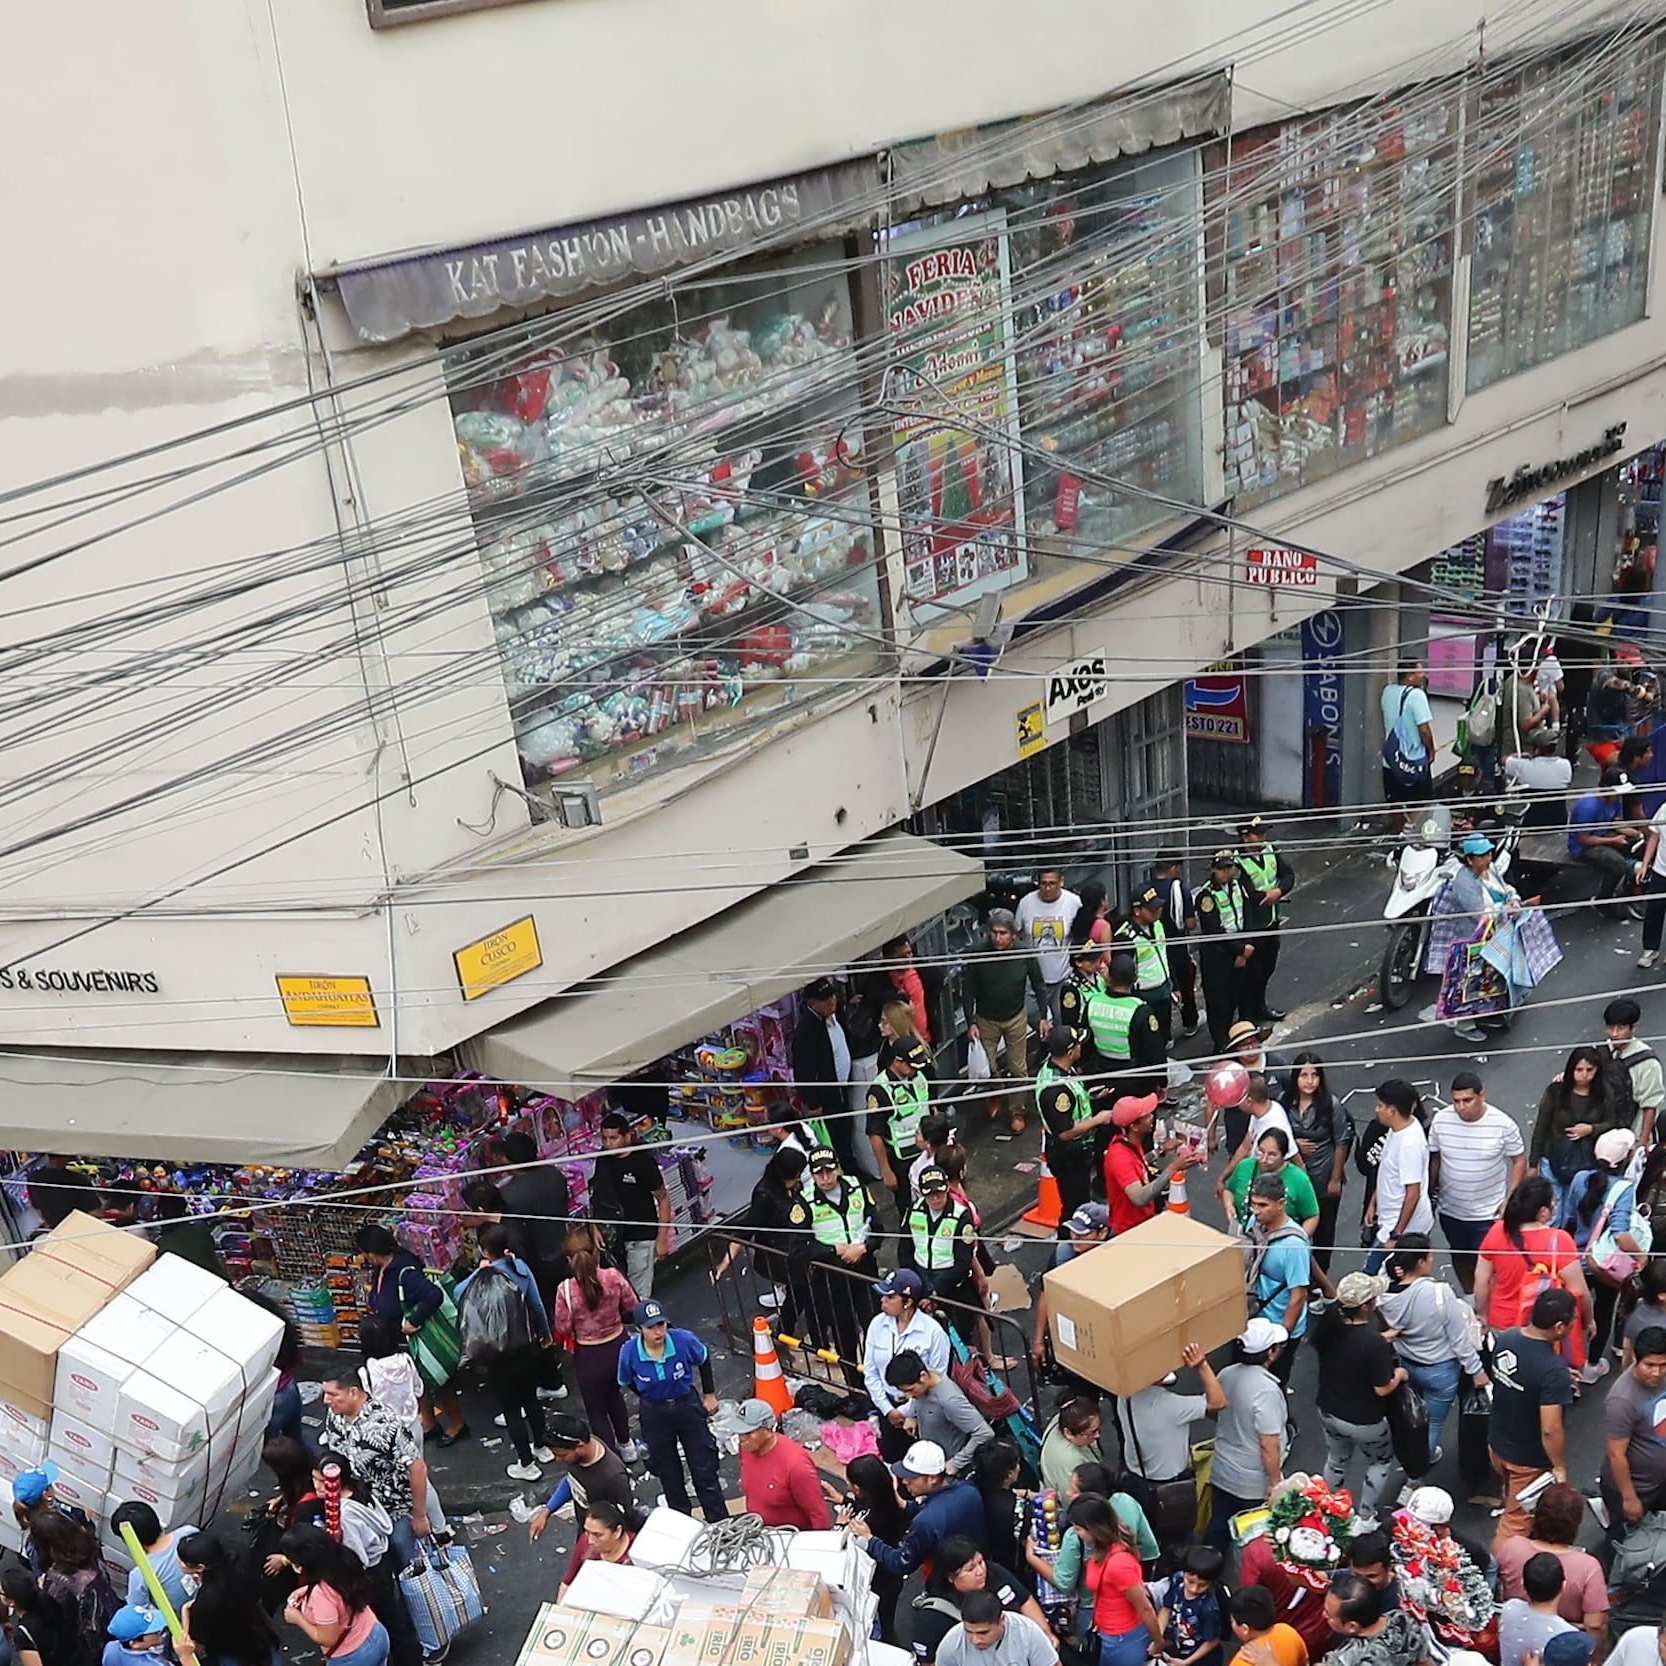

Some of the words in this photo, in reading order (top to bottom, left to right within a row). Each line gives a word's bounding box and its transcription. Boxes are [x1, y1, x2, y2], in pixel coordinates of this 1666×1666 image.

[445, 250, 500, 302] KAT
[646, 184, 802, 252] HANDBAGS
[906, 249, 978, 293] FERIA
[1247, 567, 1315, 585] PUBLICO
[1048, 658, 1106, 707] AXOS
[1218, 717, 1240, 734] 221
[1316, 652, 1342, 767] SABONIS
[479, 940, 517, 967] CUSCO
[17, 970, 34, 991] &
[35, 968, 160, 994] SOUVENIRS
